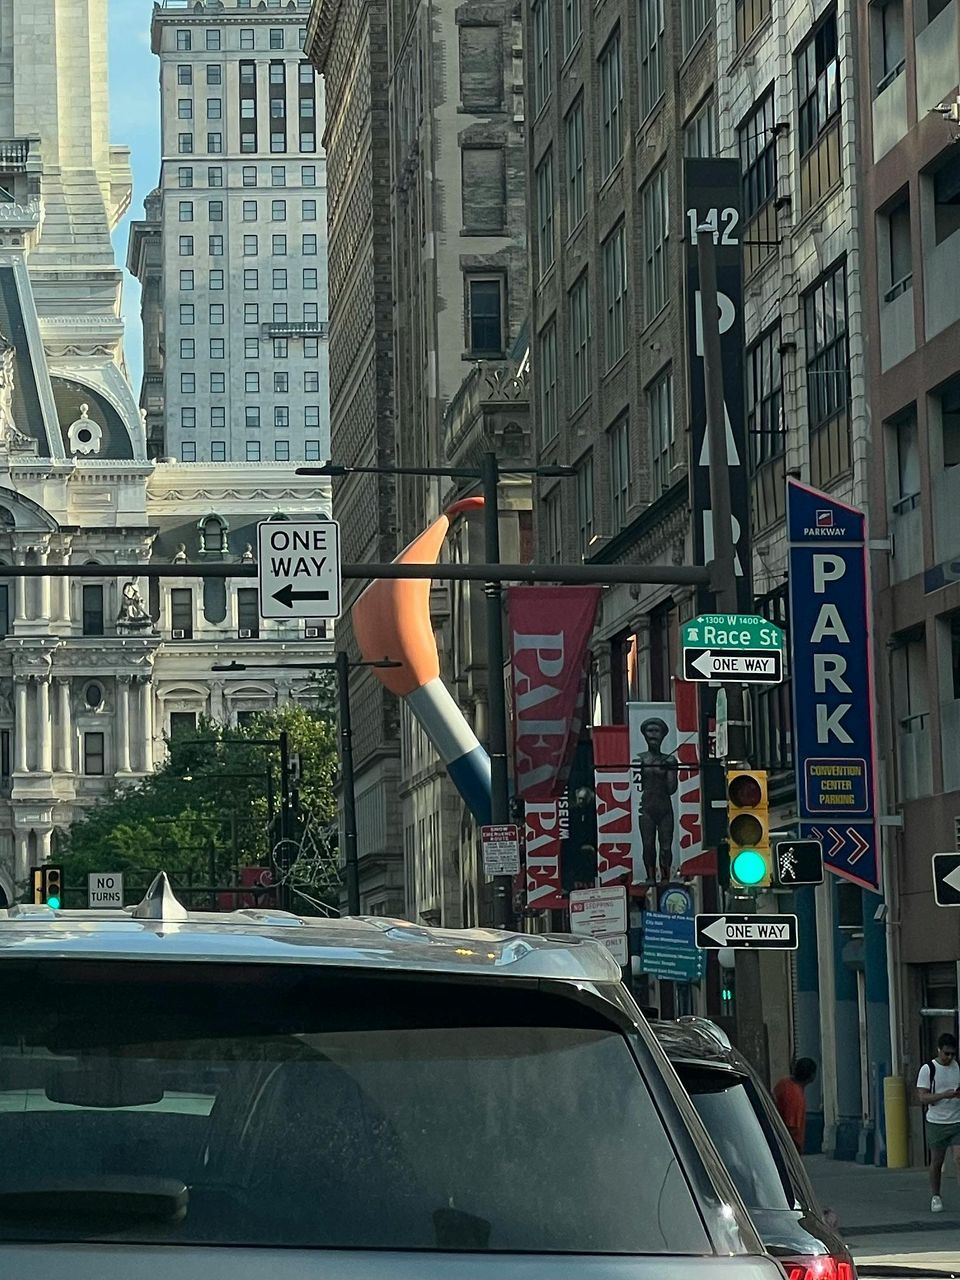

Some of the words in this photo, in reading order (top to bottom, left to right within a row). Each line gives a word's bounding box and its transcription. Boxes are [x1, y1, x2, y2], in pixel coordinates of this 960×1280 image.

[687, 207, 739, 245] 142
[804, 527, 846, 536] PARKWAY
[270, 530, 327, 551] ONE
[271, 556, 327, 577] WAY
[705, 616, 724, 624] 1300
[727, 616, 737, 626] W
[739, 617, 759, 625] 1400
[704, 626, 751, 645] Race
[760, 628, 778, 646] St
[810, 553, 854, 744] PARK
[713, 658, 739, 671] ONE
[745, 659, 769, 671] WAY
[513, 630, 565, 797] PAFA
[809, 765, 862, 776] CONVENTION
[820, 780, 852, 790] CENTER
[819, 794, 855, 805] PARKING
[594, 768, 632, 886] PAFA
[525, 800, 559, 906] PAFA
[97, 878, 115, 889] NO
[91, 892, 120, 902] TURNS
[726, 925, 752, 938] ONE
[758, 925, 785, 938] WAY
